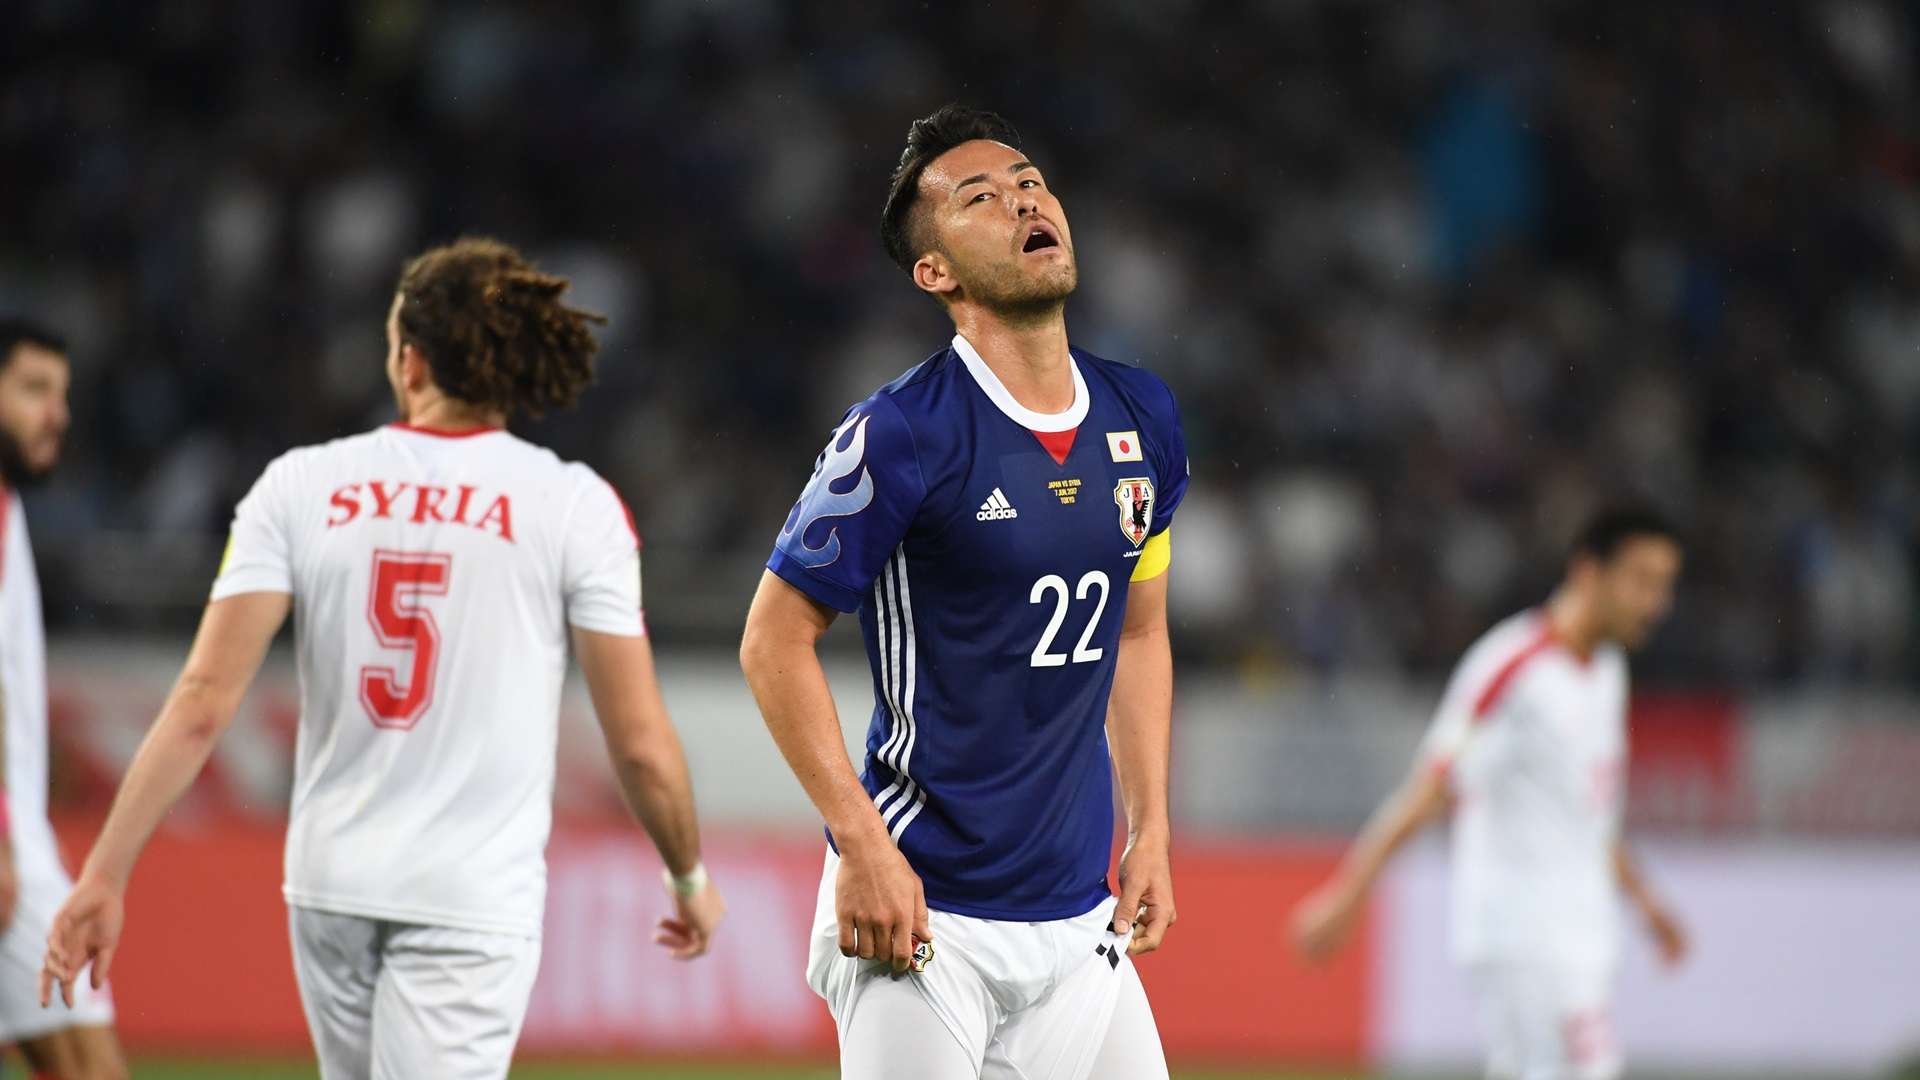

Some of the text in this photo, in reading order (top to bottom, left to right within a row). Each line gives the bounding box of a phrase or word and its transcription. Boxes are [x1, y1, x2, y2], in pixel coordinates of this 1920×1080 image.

[1048, 481, 1062, 489] JAPAN
[1060, 496, 1075, 504] TOKYO
[327, 481, 516, 543] SYRIA
[976, 508, 1018, 521] adidas
[1029, 570, 1110, 667] 22
[358, 548, 453, 731] 5
